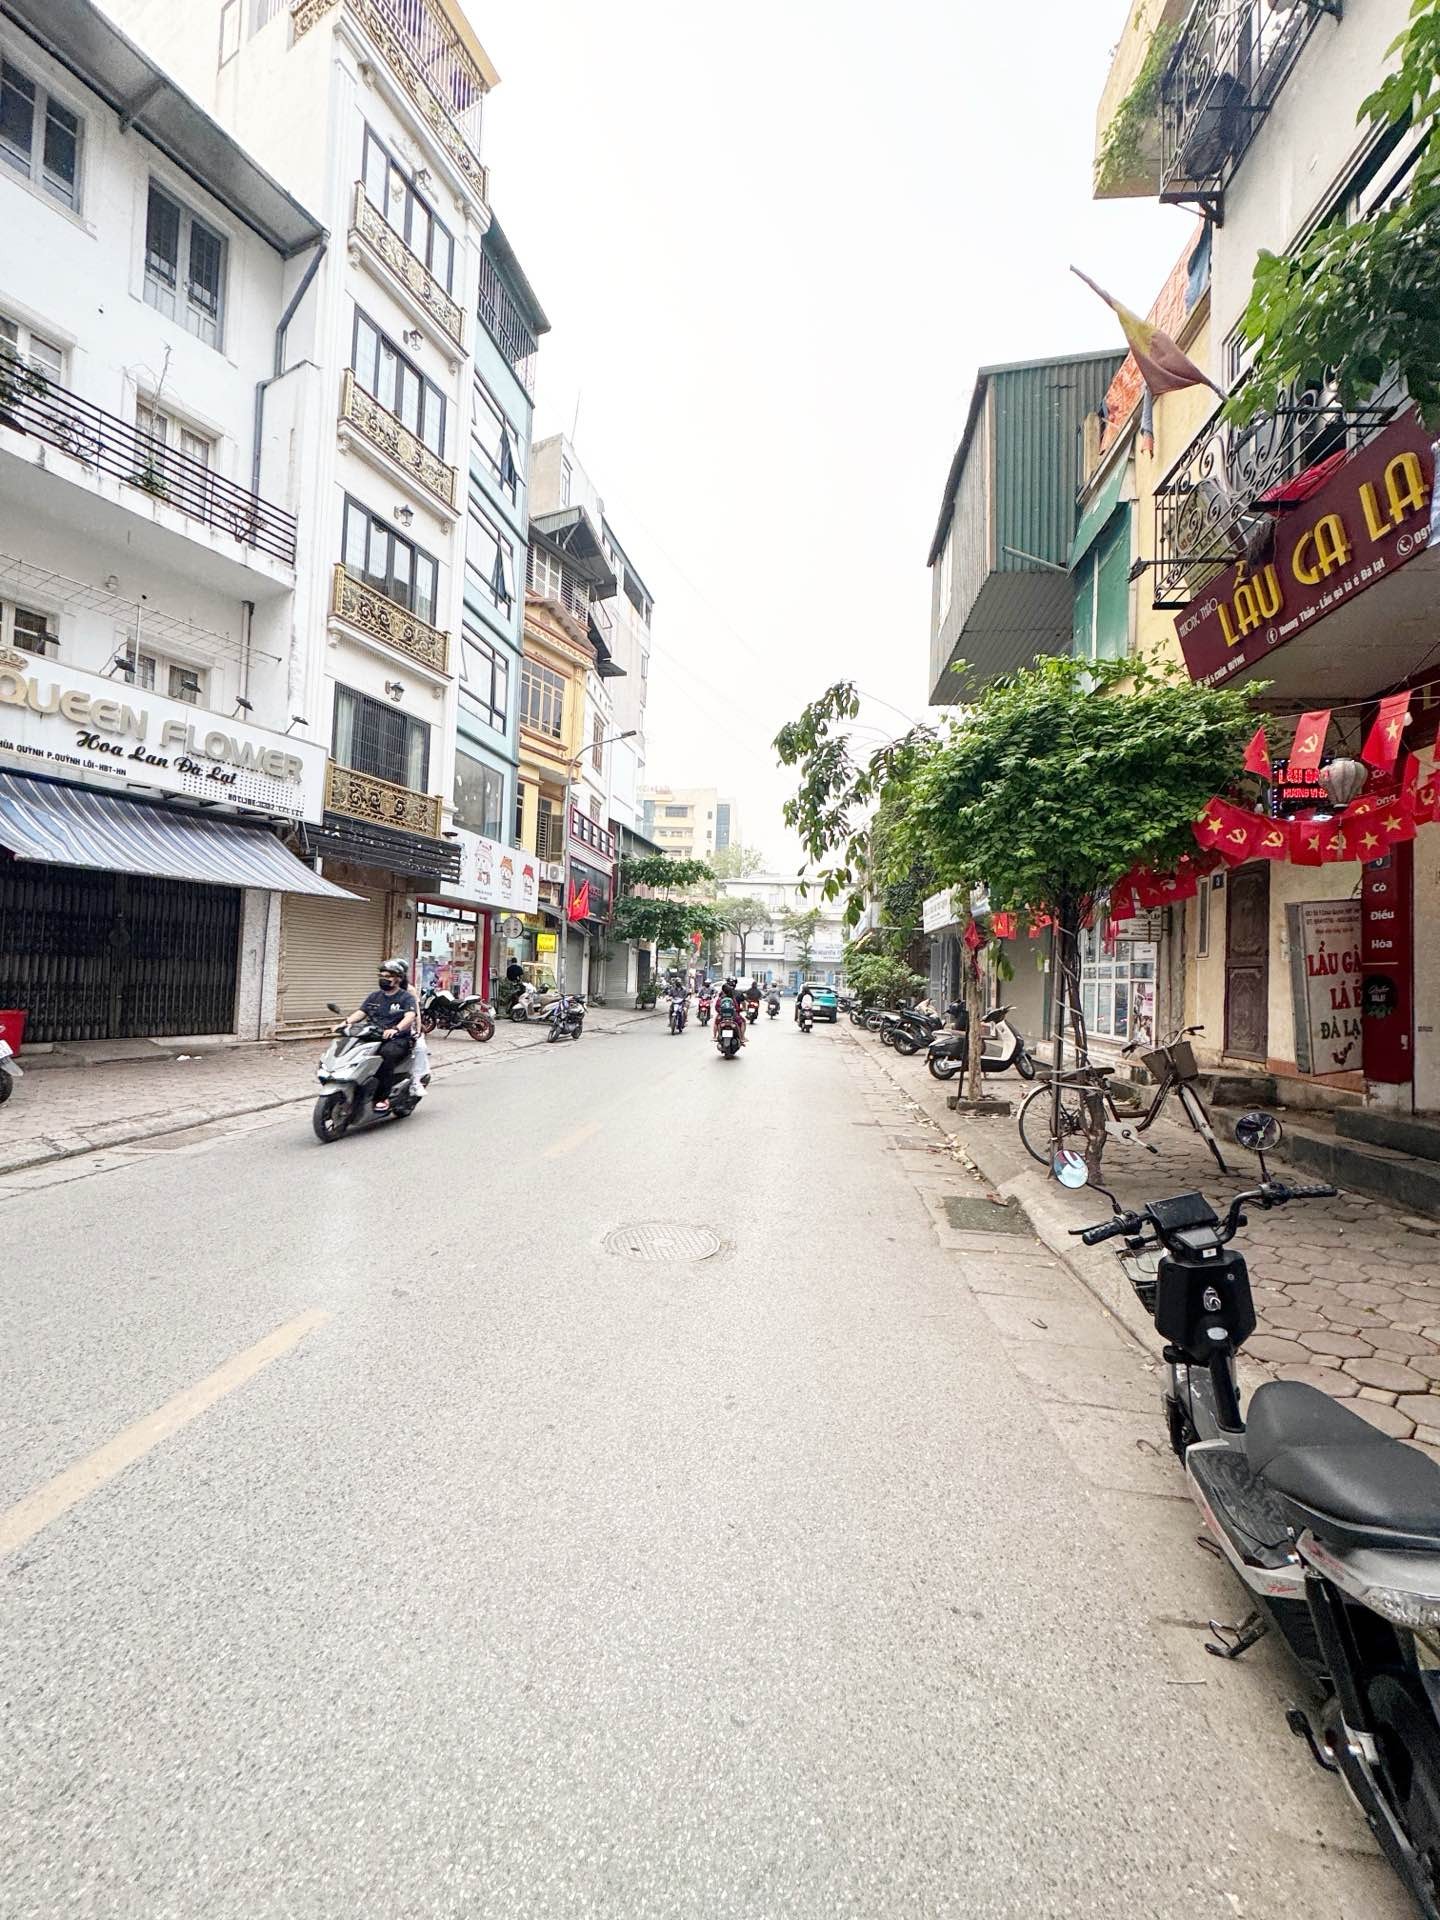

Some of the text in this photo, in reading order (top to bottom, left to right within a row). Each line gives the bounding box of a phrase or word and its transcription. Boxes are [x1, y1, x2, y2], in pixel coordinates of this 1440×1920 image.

[0, 667, 304, 785] QUEEN FLOWER
[76, 730, 124, 757] Hoa
[127, 745, 169, 769] Lan
[173, 756, 202, 777] Đà
[1307, 941, 1338, 976] LẨU
[1330, 980, 1352, 1010] LÁ
[1321, 1015, 1363, 1039] ĐÀ LẠ
